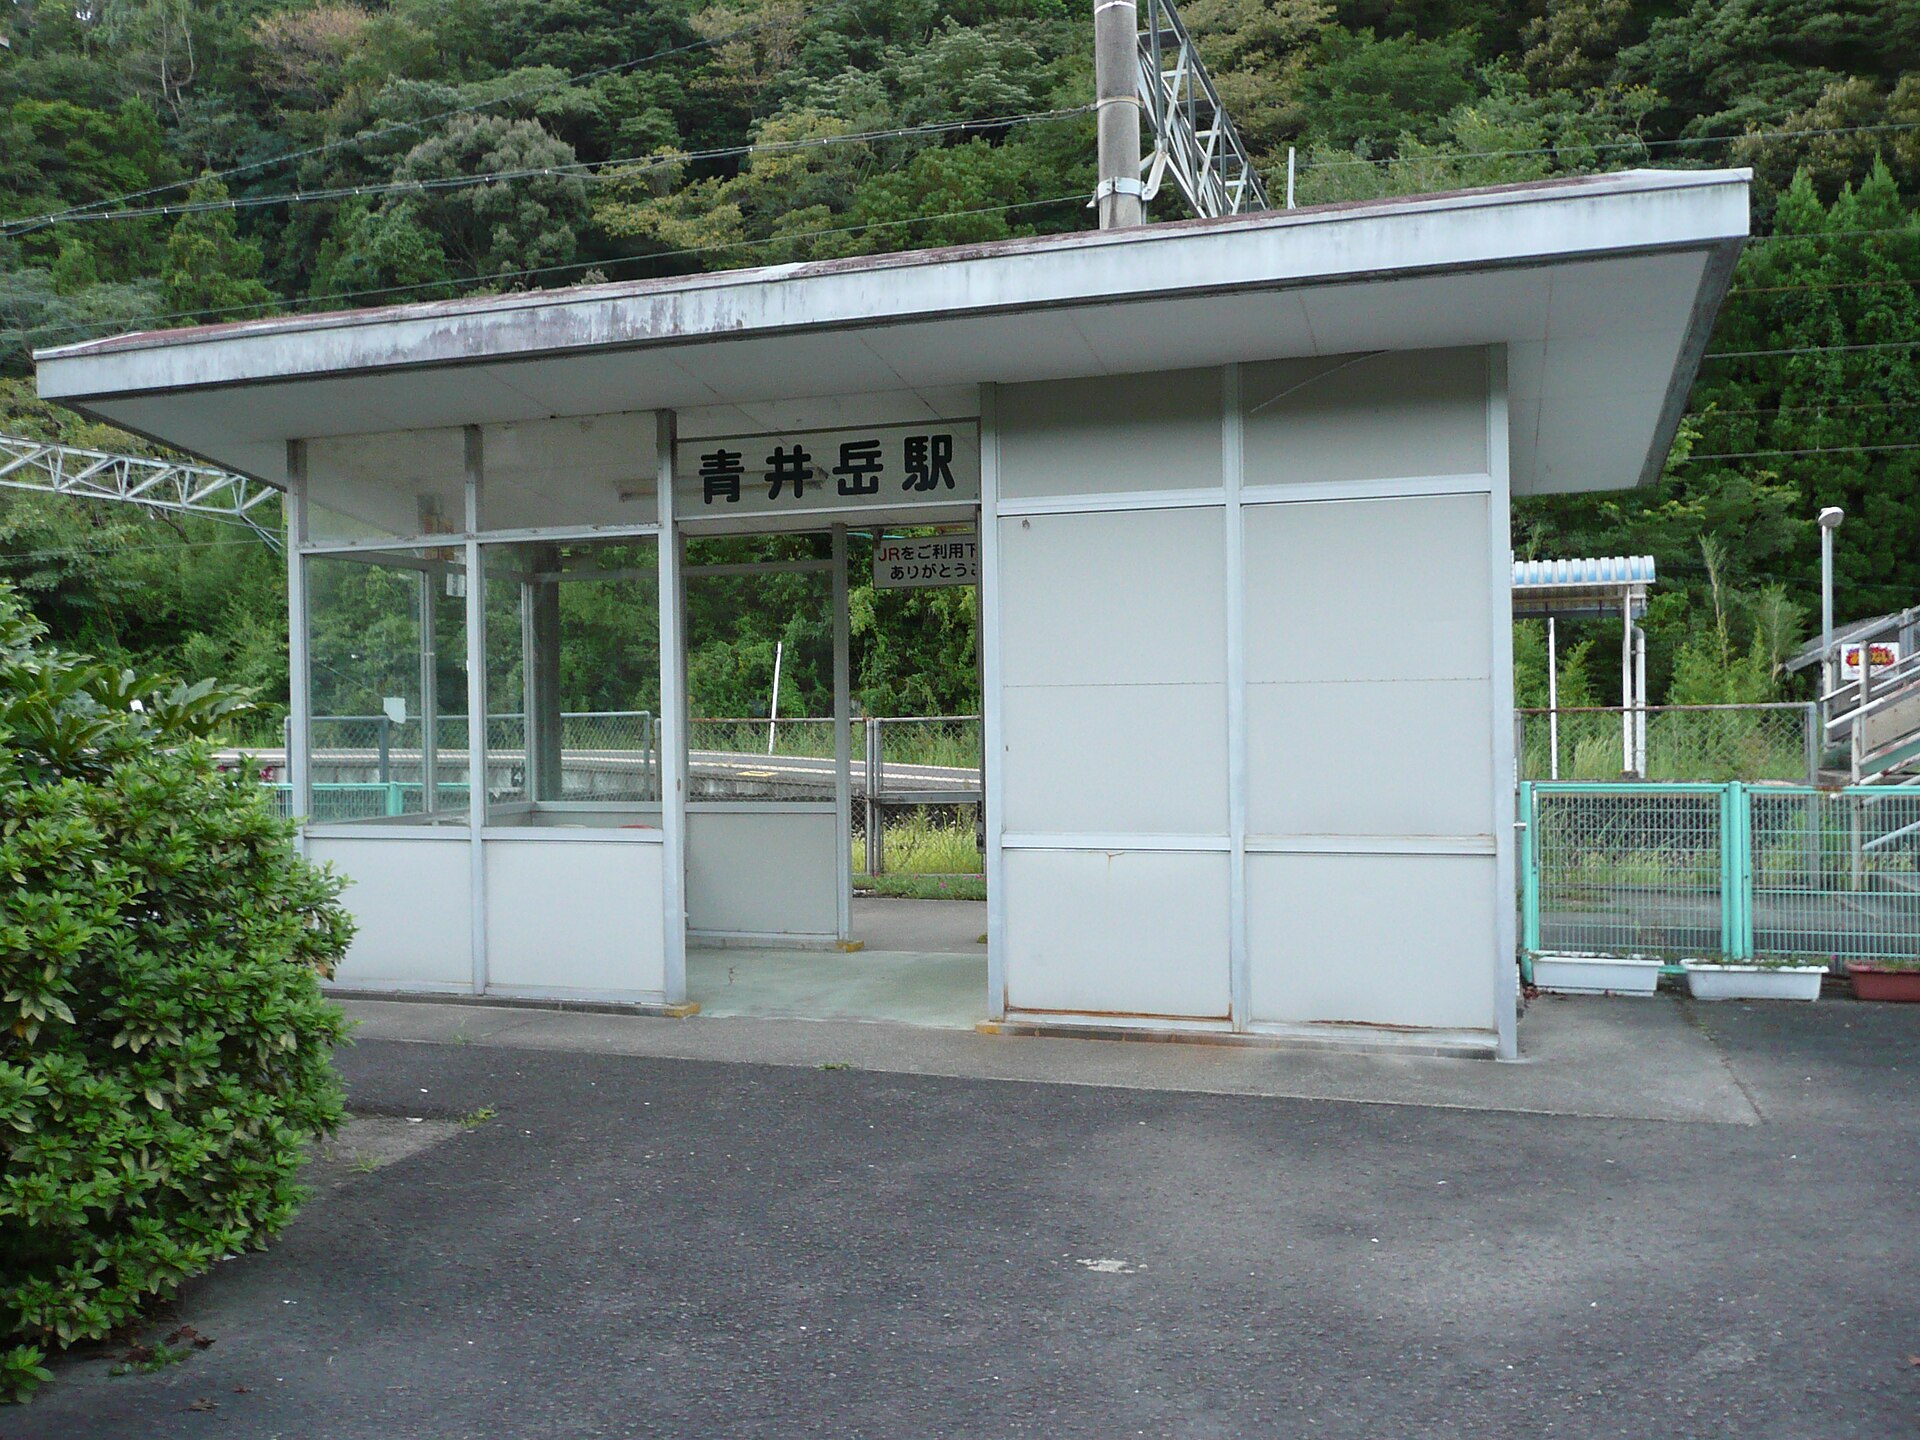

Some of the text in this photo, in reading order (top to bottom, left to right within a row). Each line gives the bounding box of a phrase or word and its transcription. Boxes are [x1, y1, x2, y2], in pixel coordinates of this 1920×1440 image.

[699, 435, 956, 504] 青井岳駅
[890, 563, 976, 580] ありがとう
